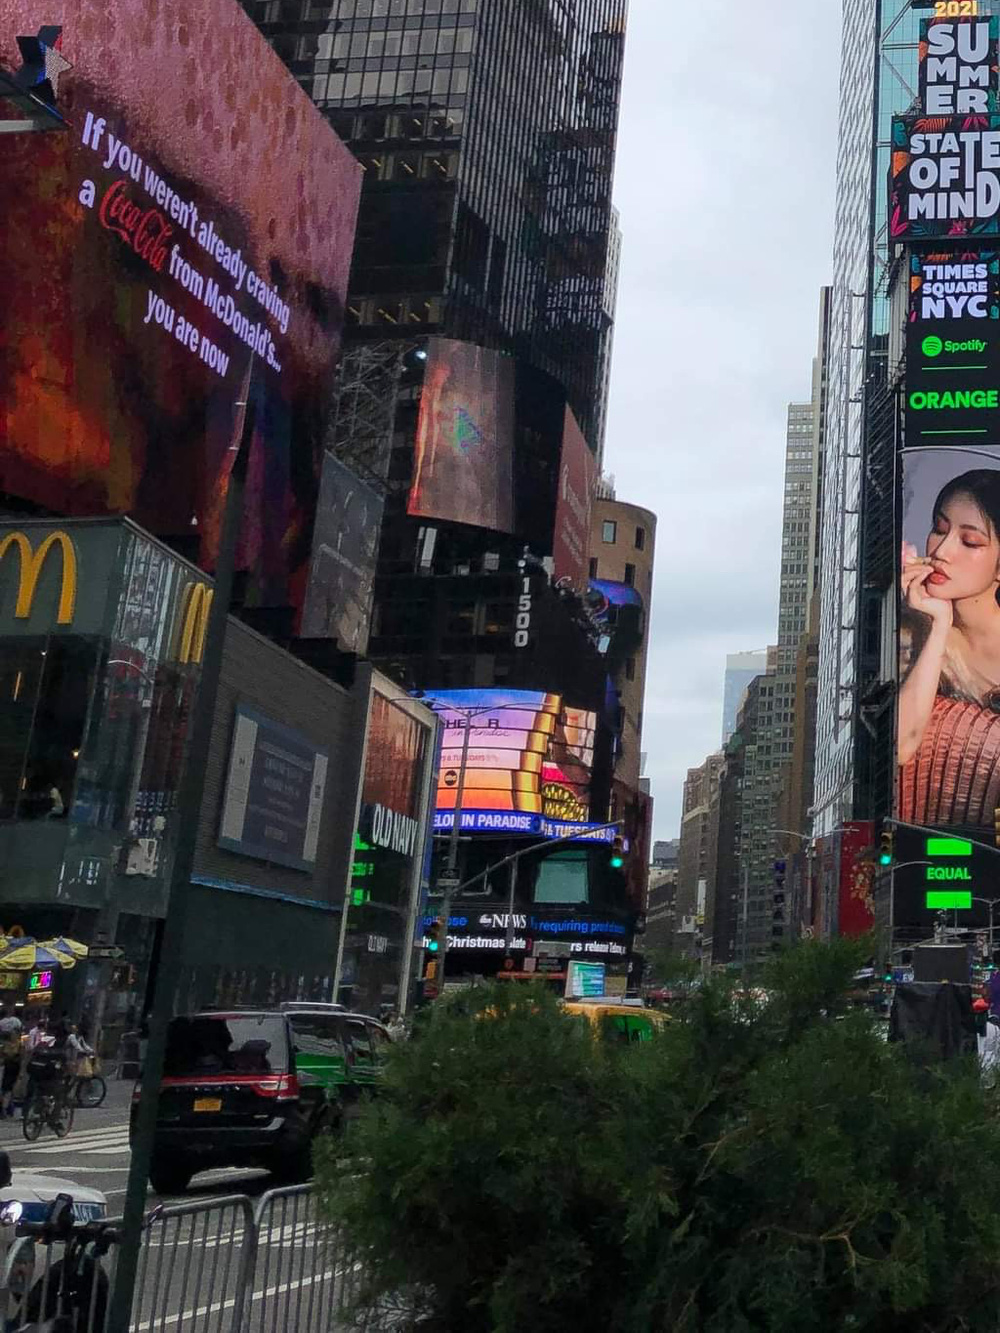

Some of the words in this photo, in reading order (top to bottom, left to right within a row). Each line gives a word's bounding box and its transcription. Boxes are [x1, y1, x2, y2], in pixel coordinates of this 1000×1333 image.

[934, 1, 979, 18] 2021
[909, 156, 960, 191] OF
[908, 170, 1000, 221] MIND
[82, 112, 106, 151] If
[103, 132, 143, 183] you
[143, 165, 199, 239] weren't
[198, 220, 249, 290] already
[246, 268, 291, 335] craving
[79, 179, 97, 209] a
[169, 244, 204, 301] from
[922, 263, 989, 280] TIMES
[922, 281, 989, 296] SQUARE
[921, 295, 988, 320] NYC
[143, 290, 175, 334] you
[175, 315, 200, 354] are
[199, 334, 229, 378] now
[944, 337, 988, 354] Spotify
[909, 390, 999, 410] ORANGE
[514, 577, 531, 647] 1500
[372, 803, 393, 848] OLD
[392, 812, 418, 857] NAVY
[462, 814, 475, 827] IN
[478, 814, 531, 829] PARADISE
[926, 867, 972, 880] EQUAL
[540, 919, 588, 933] requiring
